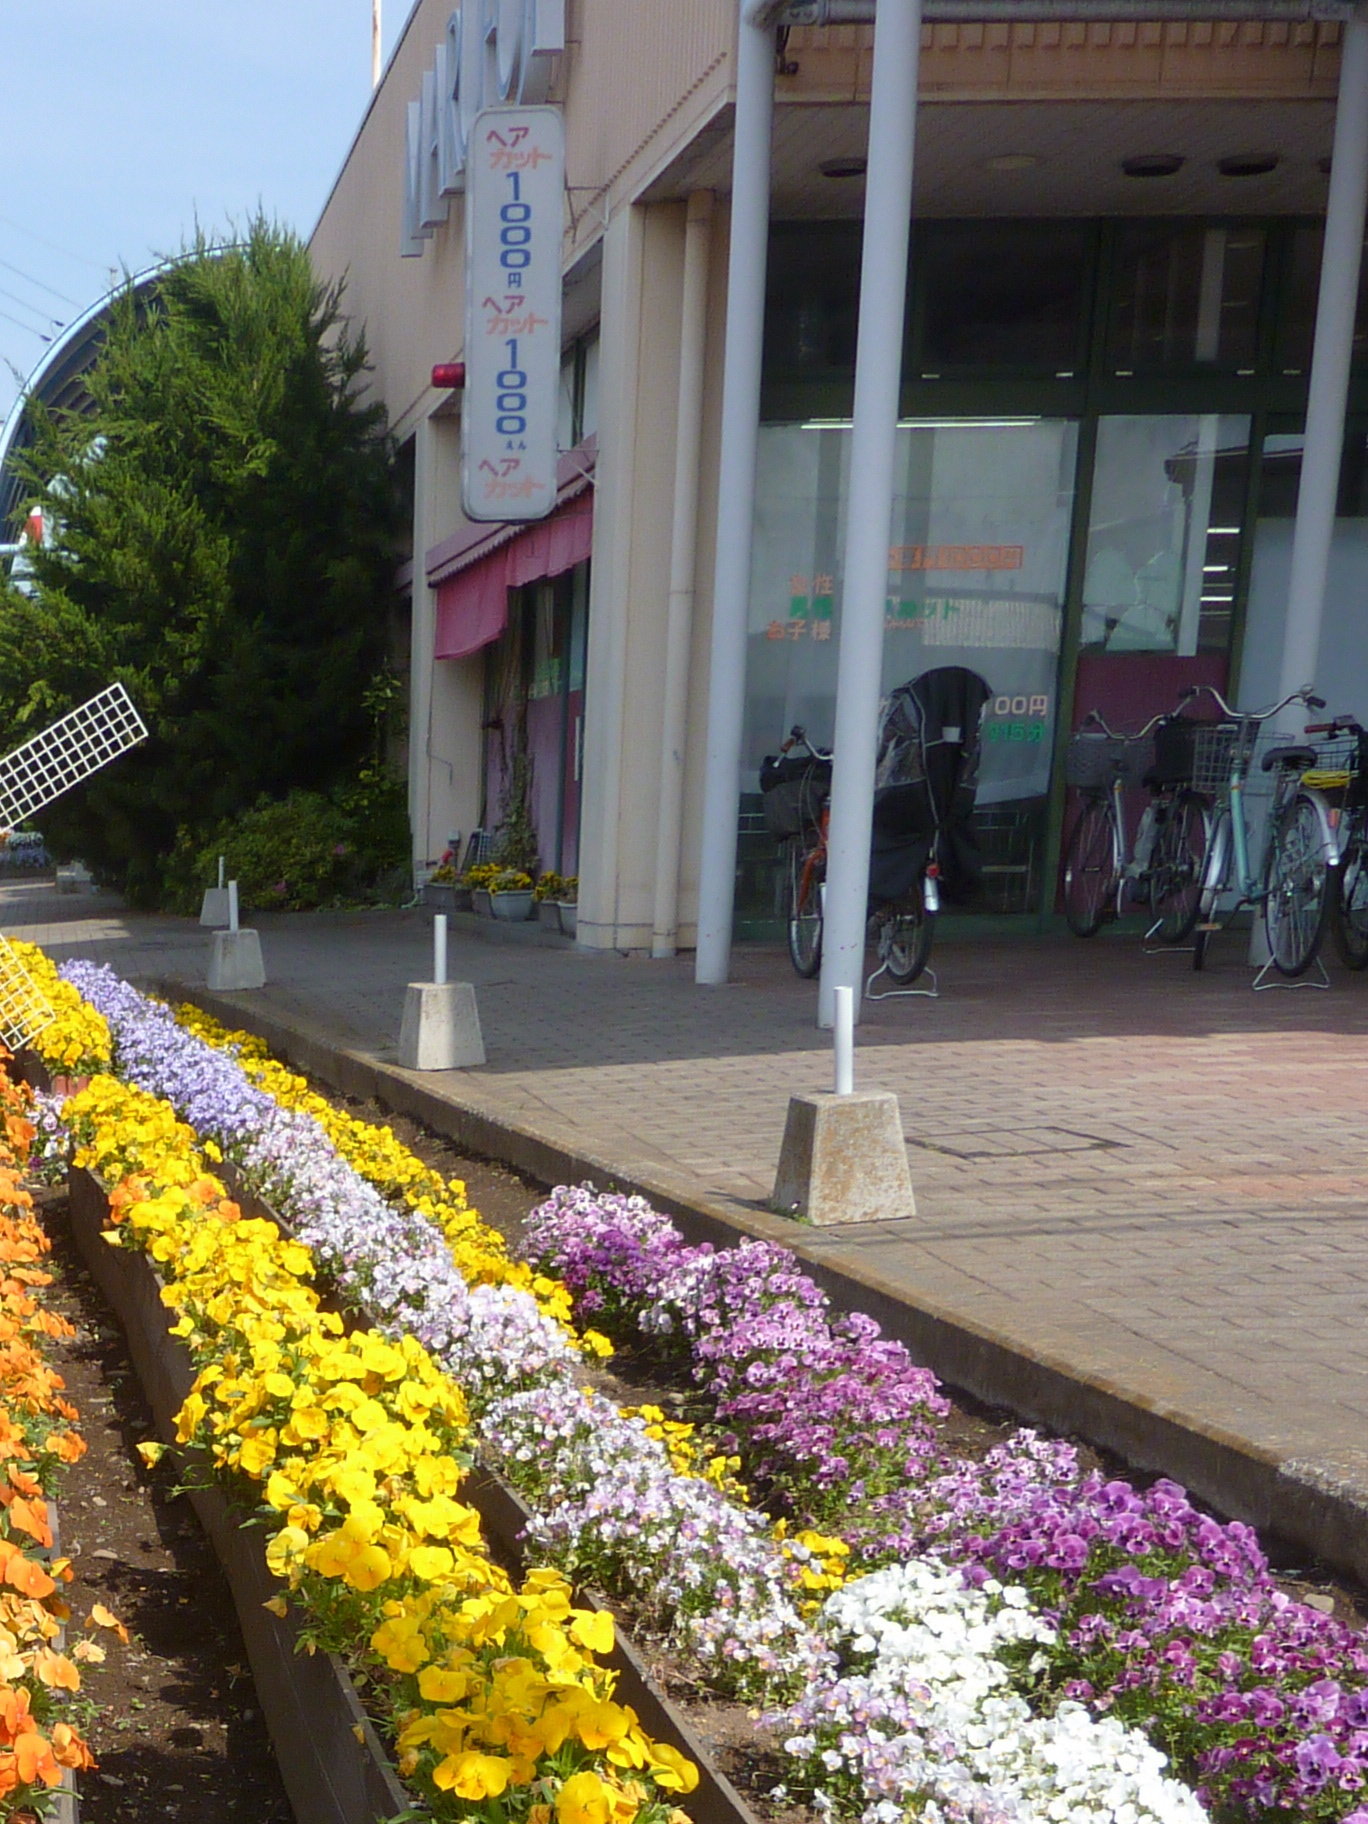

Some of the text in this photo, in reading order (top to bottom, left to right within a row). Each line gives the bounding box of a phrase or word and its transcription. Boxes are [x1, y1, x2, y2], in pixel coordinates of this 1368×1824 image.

[486, 126, 529, 148] ヘア
[489, 147, 553, 170] カット
[482, 295, 525, 314] ヘア
[485, 313, 549, 335] カット
[478, 458, 521, 478] ヘア
[994, 694, 1050, 717] 00円
